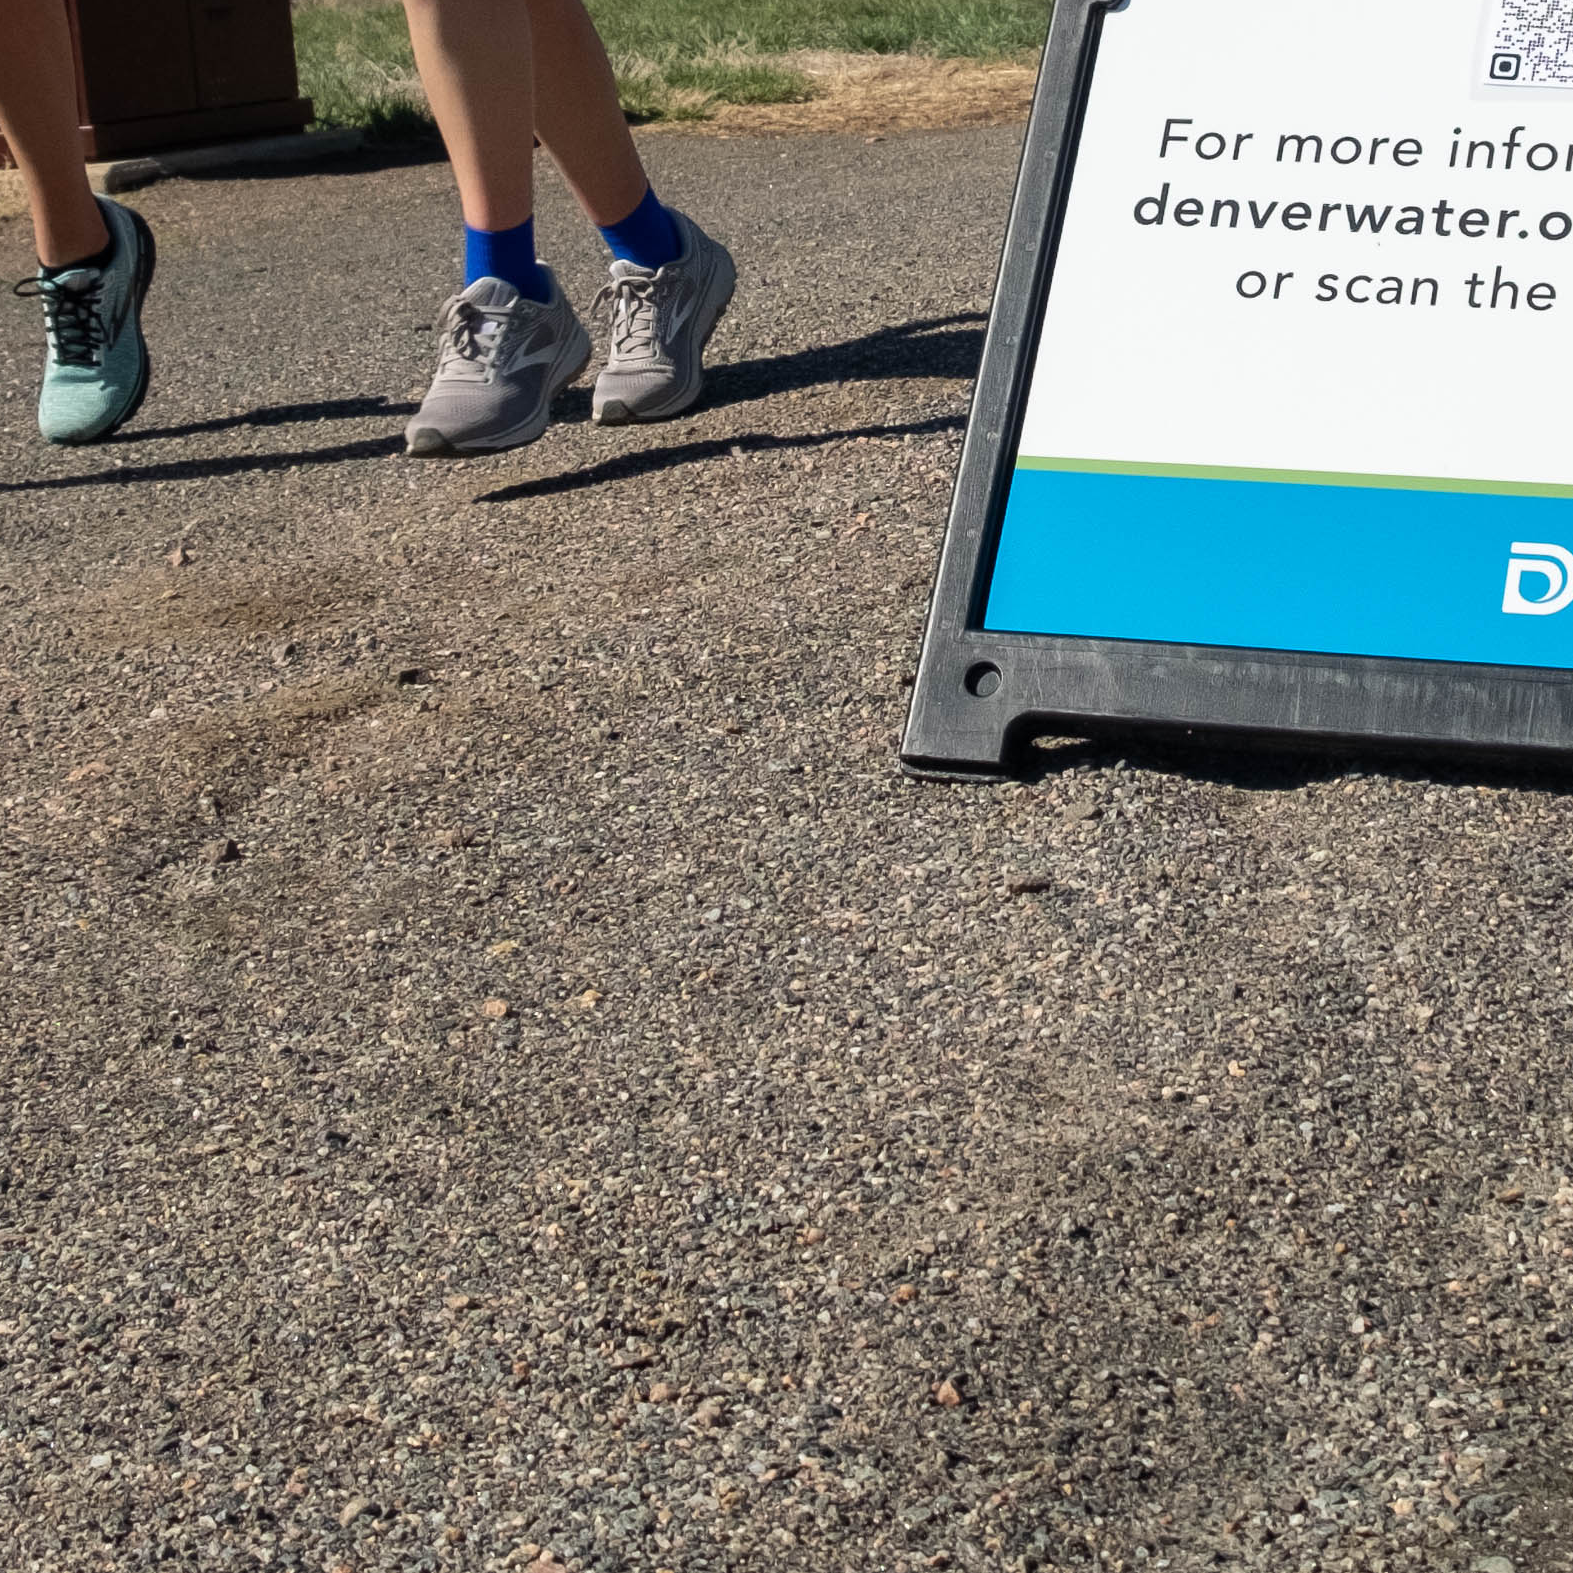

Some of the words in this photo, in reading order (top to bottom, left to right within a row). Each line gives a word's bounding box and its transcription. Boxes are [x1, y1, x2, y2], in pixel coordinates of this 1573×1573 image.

[1159, 118, 1254, 161] For
[1276, 134, 1423, 170] more
[1235, 270, 1294, 301] or
[1315, 273, 1439, 306] scan
[1464, 265, 1557, 311] the
